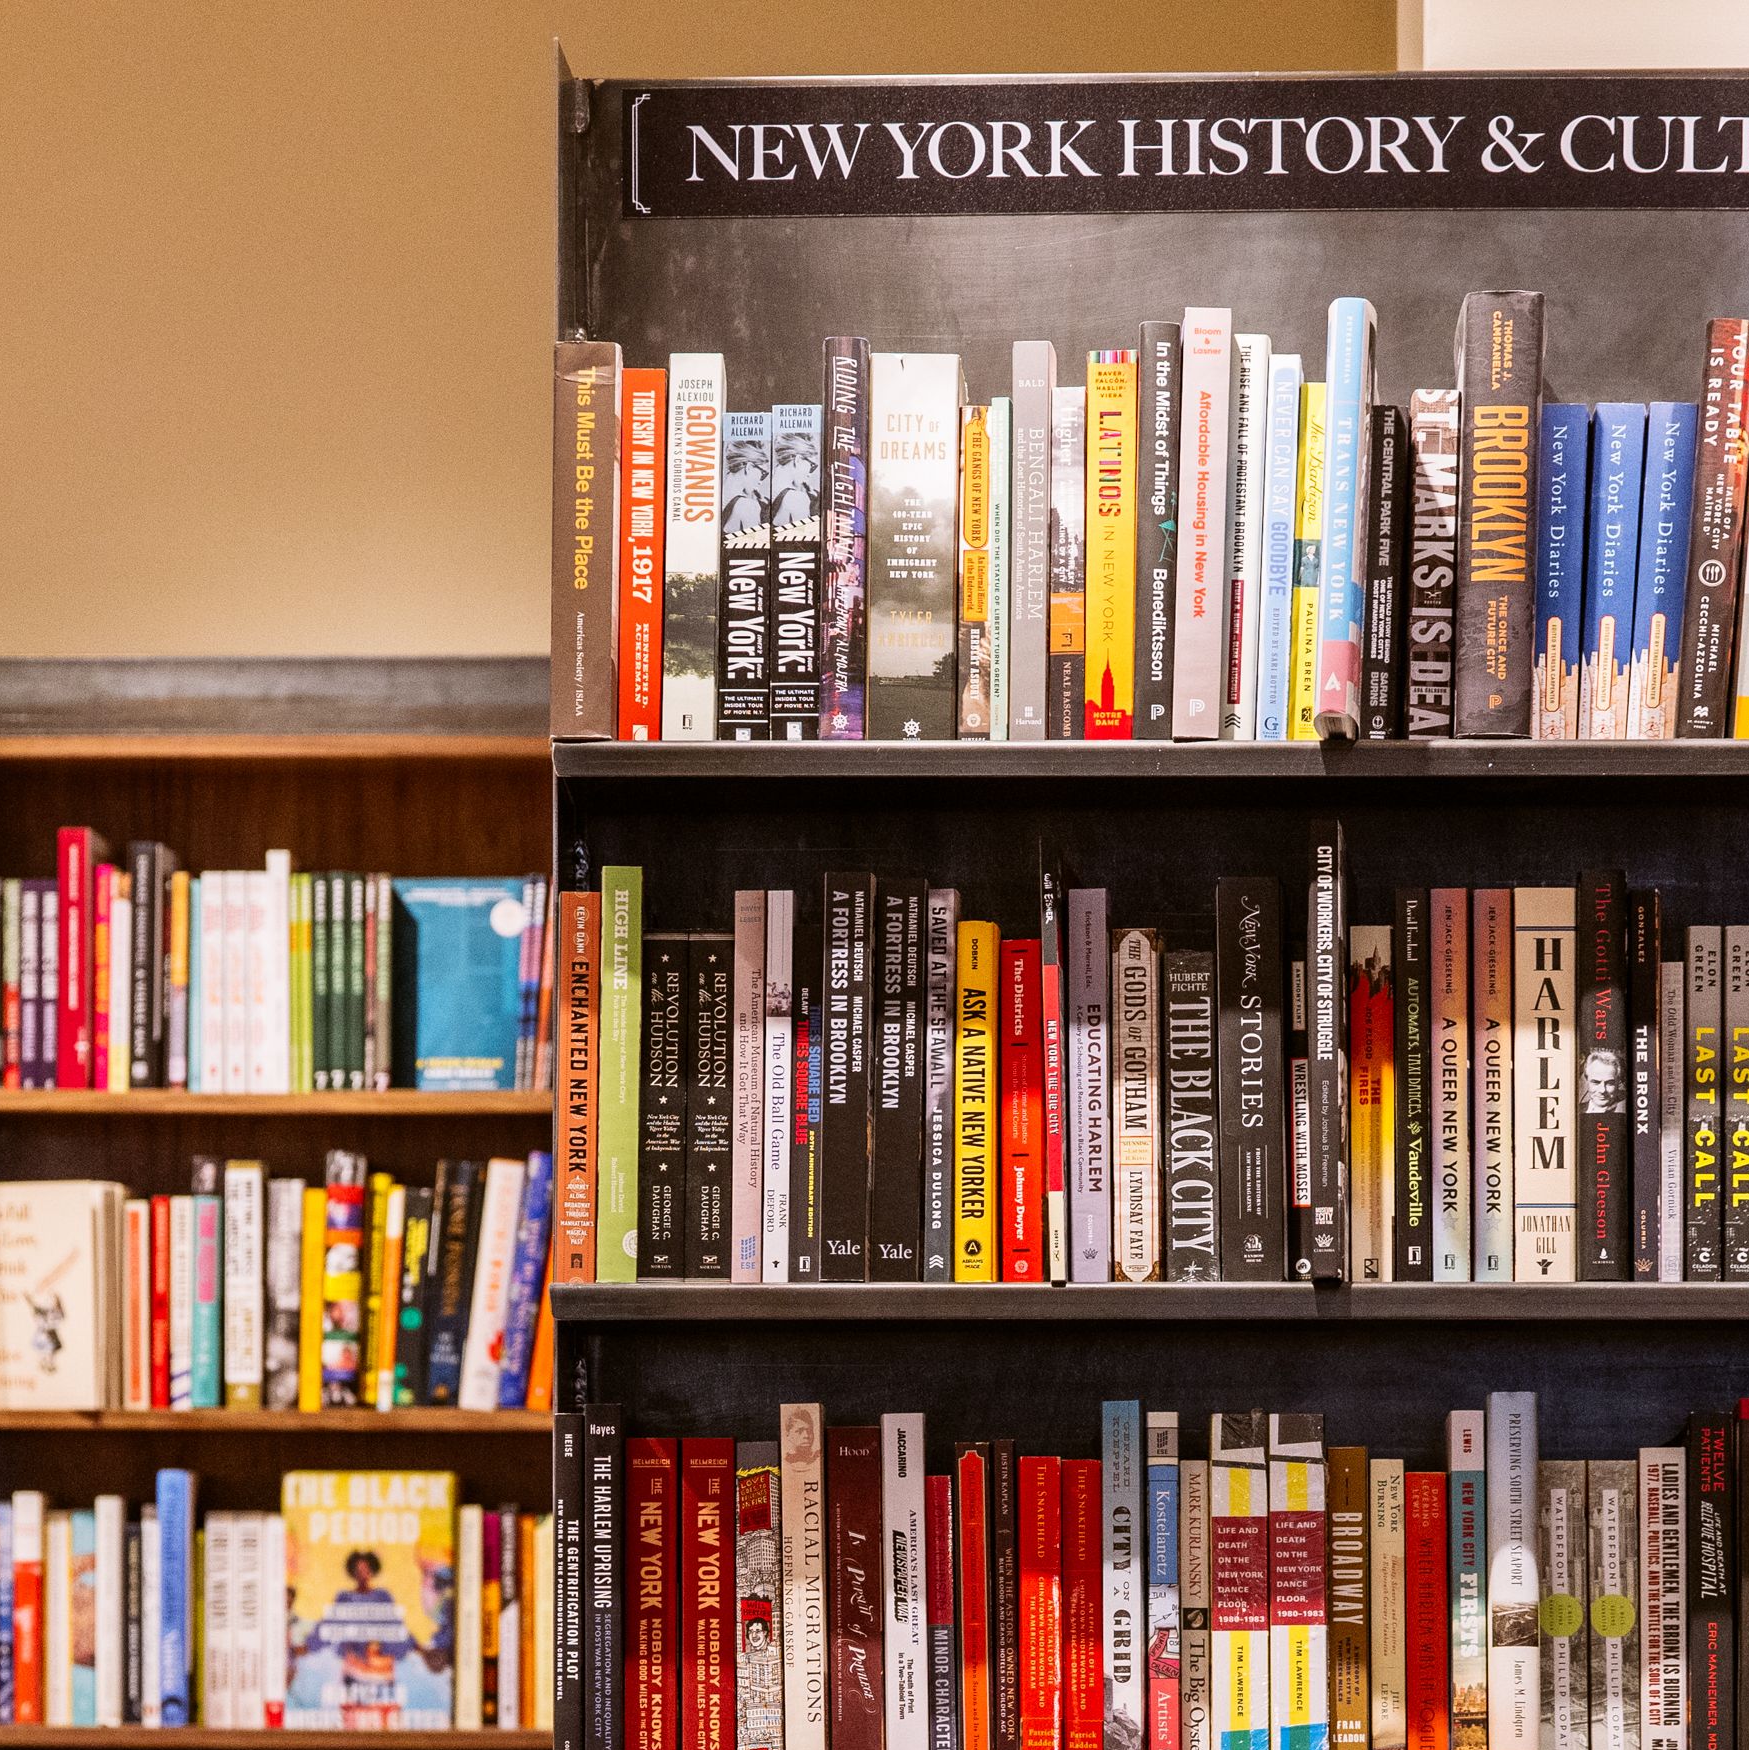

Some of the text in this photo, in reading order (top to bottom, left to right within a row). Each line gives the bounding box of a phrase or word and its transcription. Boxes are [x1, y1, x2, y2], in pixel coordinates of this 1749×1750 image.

[685, 122, 862, 182] NEW
[881, 119, 1102, 179] YORK
[1118, 113, 1465, 179] HISTORY
[1481, 115, 1545, 174] &
[676, 392, 714, 402] ALEXIOU
[679, 379, 713, 389] JOSEPH
[731, 415, 764, 426] RICHARD
[1151, 341, 1171, 515] In the Midst of Things
[685, 405, 716, 524] GOWANUS
[731, 427, 764, 437] ALLEMAN
[575, 366, 595, 590] This Must Be the Place
[1471, 406, 1529, 582] BROOKLYN
[1099, 411, 1122, 641] LATINOS IN NEW YORK
[1411, 455, 1457, 644] MARKS IS
[777, 552, 815, 673] New York:
[1151, 569, 1167, 681] Benediktsson
[1093, 711, 1122, 719] NOTRE
[1095, 718, 1119, 726] DAME
[1170, 973, 1209, 982] HUBERT
[1172, 982, 1207, 992] FICHTE
[569, 961, 589, 1172] ENCHANTED NEW YORK
[1240, 995, 1263, 1128] STORIES
[1529, 937, 1567, 1169] HARLEM
[961, 987, 986, 1219] ASK A NATIVE NEW YORKER
[1169, 997, 1215, 1255] THE BLACK CITY
[827, 1240, 861, 1257] Yale
[1521, 1215, 1571, 1233] JONATHAN
[1536, 1237, 1556, 1255] GILL
[590, 1424, 616, 1435] Hayes
[594, 1455, 612, 1608] THE HARLEM UPRISING
[1332, 1512, 1364, 1625] BROADWAY
[804, 1480, 823, 1723] RACIAL MIGRATIONS
[1277, 1580, 1308, 1588] DANCE
[1333, 1734, 1365, 1743] LEADON
[1337, 1720, 1362, 1730] FRAN
